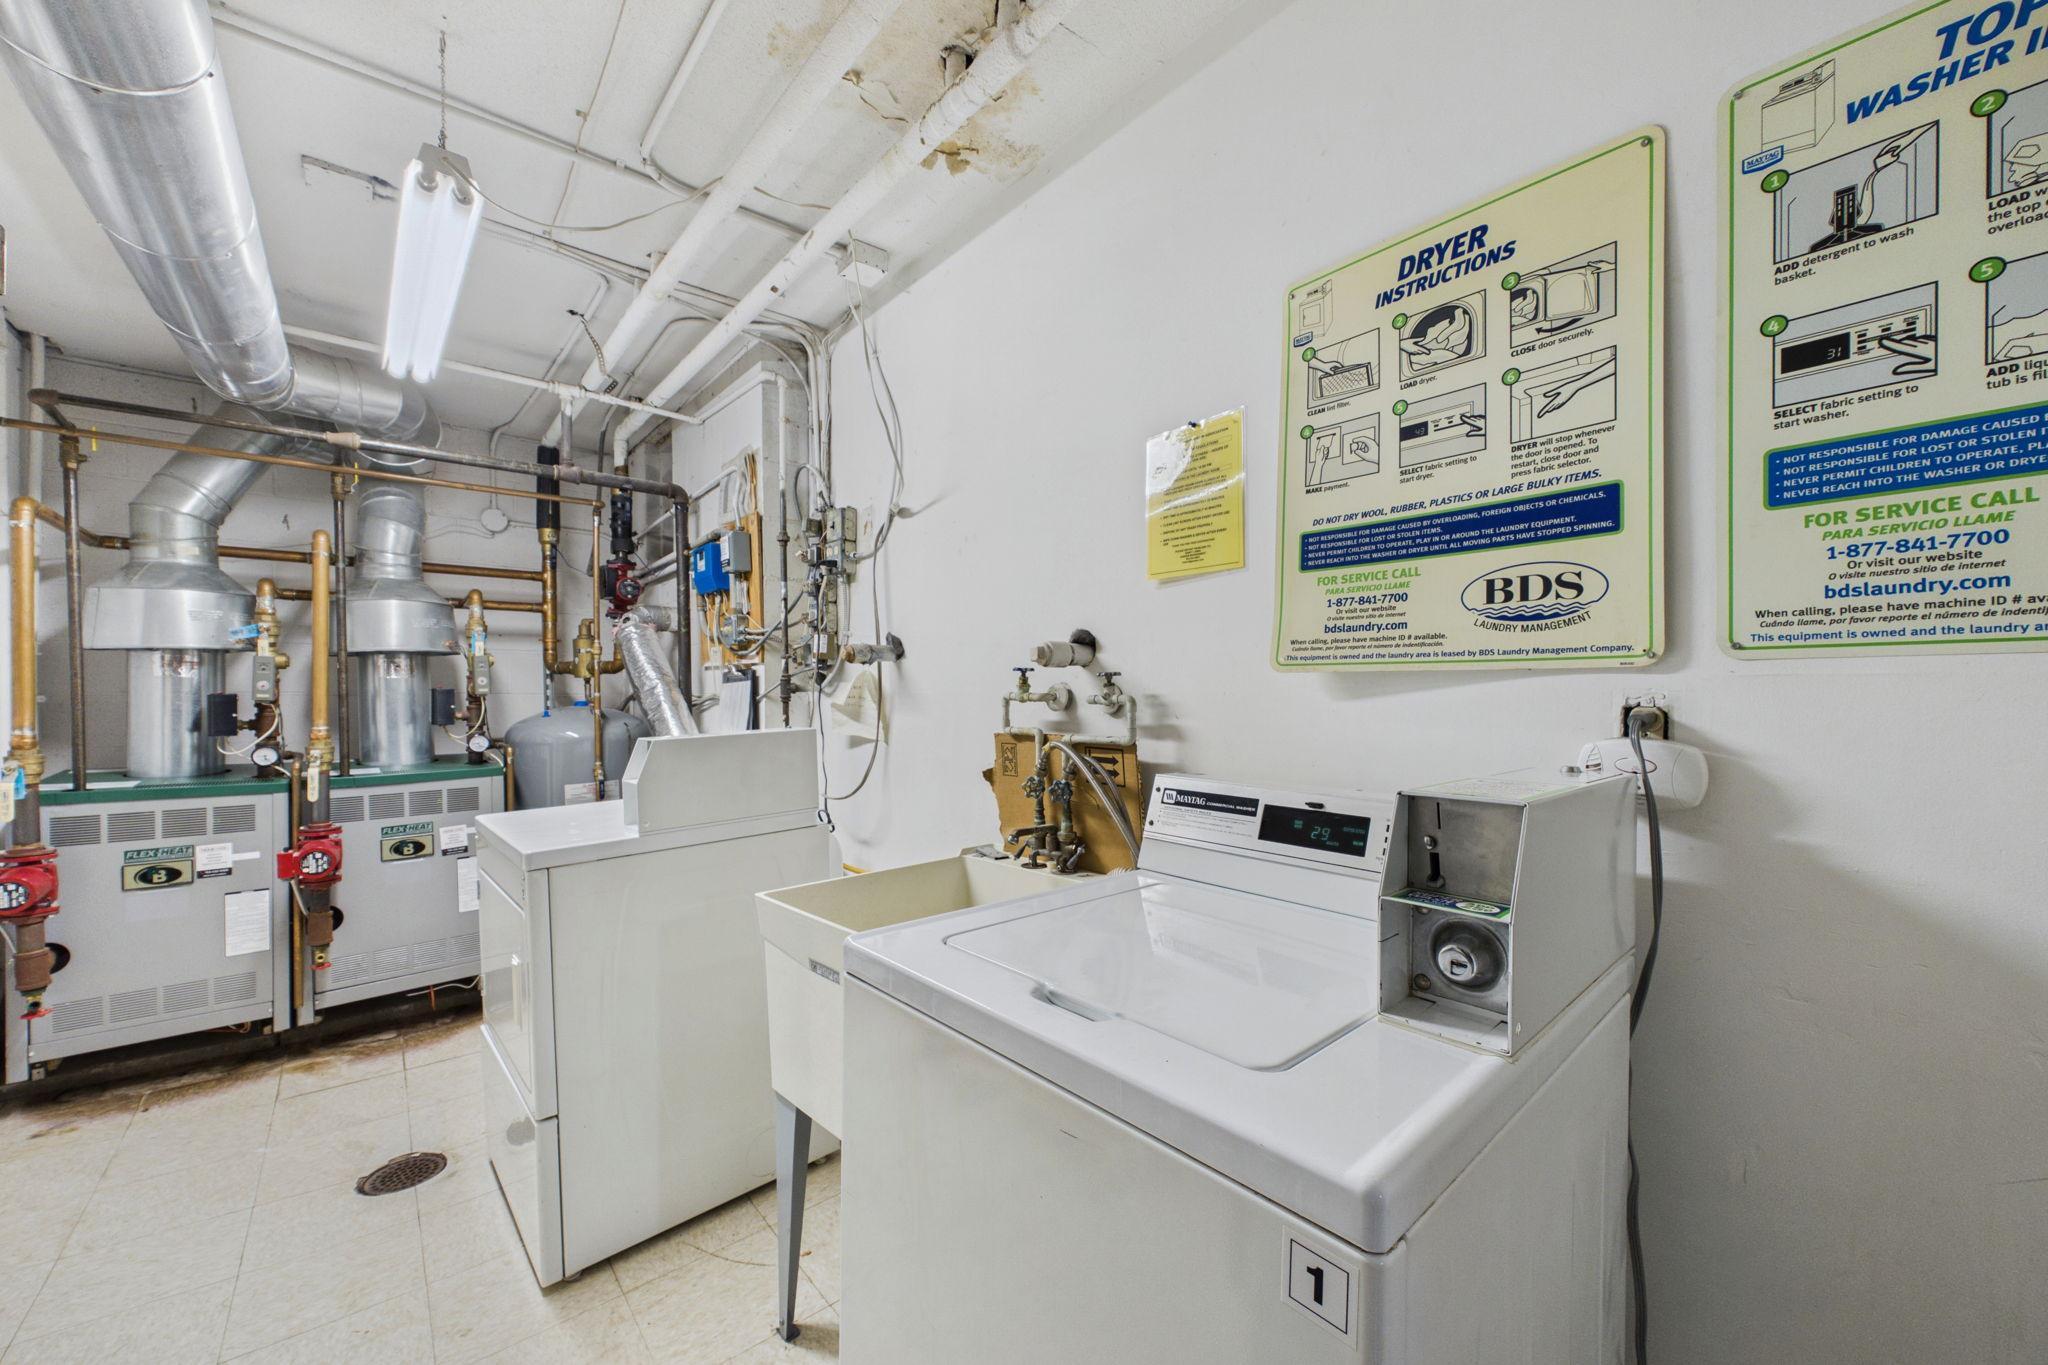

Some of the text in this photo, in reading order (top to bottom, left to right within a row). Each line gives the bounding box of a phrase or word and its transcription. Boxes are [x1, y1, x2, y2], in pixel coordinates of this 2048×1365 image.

[1846, 39, 2015, 124] WASHER
[1982, 96, 1994, 112] 2
[1746, 150, 1779, 167] MAYTAG
[1771, 175, 1780, 188] 1
[1989, 191, 2031, 211] LOAD
[1987, 202, 2041, 223] the top
[1397, 224, 1489, 282] DRYER
[1774, 227, 1914, 276] ADD detergent to wash
[1375, 240, 1516, 309] INSTRUCTIONS
[1508, 275, 1515, 287] 3
[1774, 268, 1816, 286] basket.
[1981, 263, 1993, 279] 5
[1768, 320, 1778, 332] 4
[1511, 328, 1594, 357] CLOSE door securely.
[1508, 370, 1515, 381] 6
[1986, 363, 2020, 378] ADD
[1400, 375, 1438, 390] LOAD dryer.
[1987, 374, 2028, 390] tub is
[1774, 385, 1919, 420] SELECT fabric setting to
[1774, 410, 1849, 430] start washer.
[1511, 425, 1615, 453] DRYER will stop whenever
[1525, 450, 1543, 458] door
[1553, 439, 1586, 453] opened.
[1588, 437, 1598, 445] To
[1783, 415, 2040, 464] NOT RESPONSIBLE FOR DAMAGE CAUSED
[1511, 444, 1599, 469] restart, close door and
[1783, 429, 2036, 475] NOT RESPONSIBLE FOR LOST OR STOLEN
[1400, 465, 1424, 477] SELECT
[1425, 463, 1443, 471] fabric
[1445, 457, 1468, 467] setting
[1511, 457, 1591, 479] press fabric selector.
[1783, 445, 2023, 487] NEVER PERMIT CHILDREN TO OPERATE,
[1399, 473, 1436, 484] start dryer.
[1783, 460, 2005, 499] NEVER REACH INTO THE WASHER OR
[1312, 468, 1602, 526] DO NOT DRY WOOL, RUBBER, PLASTICS OR LARGE BULKY ITEMS.
[1804, 487, 2040, 528] FOR SERVICE CALL
[1822, 510, 2016, 541] PARA SERVICIO LLAME
[1827, 529, 2009, 560] 1-877-841-7700
[1839, 571, 1866, 579] visite
[1869, 568, 1910, 577] nuestro
[1913, 565, 1938, 574] sitio
[1940, 563, 1955, 572] de
[1958, 559, 2006, 570] internet
[1847, 550, 1983, 569] Or visit our website
[1317, 566, 1421, 587] FOR SERVICE CALL
[1825, 575, 2010, 599] bdslaundry.com
[1483, 571, 1584, 605] BDS
[1327, 592, 1408, 608] 1-877-841-7700
[1755, 594, 2022, 618] When calling, please have machine ID #
[1324, 621, 1408, 634] bdslaundry.com
[1473, 610, 1592, 633] LAUNDRY MANAGEMENT
[1829, 615, 1847, 626] por
[1848, 616, 1876, 625] favor
[1878, 614, 1918, 623] reporte
[1921, 612, 1932, 620] el
[1982, 609, 1998, 617] de
[1750, 622, 2029, 643] This equipment is owned and the laundry
[1175, 794, 1207, 806] MAYTAG
[382, 823, 430, 835] FLEX HEAT
[1310, 826, 1331, 841] 29
[126, 846, 191, 860] FLEX HEAT
[1306, 1265, 1324, 1306] 1
